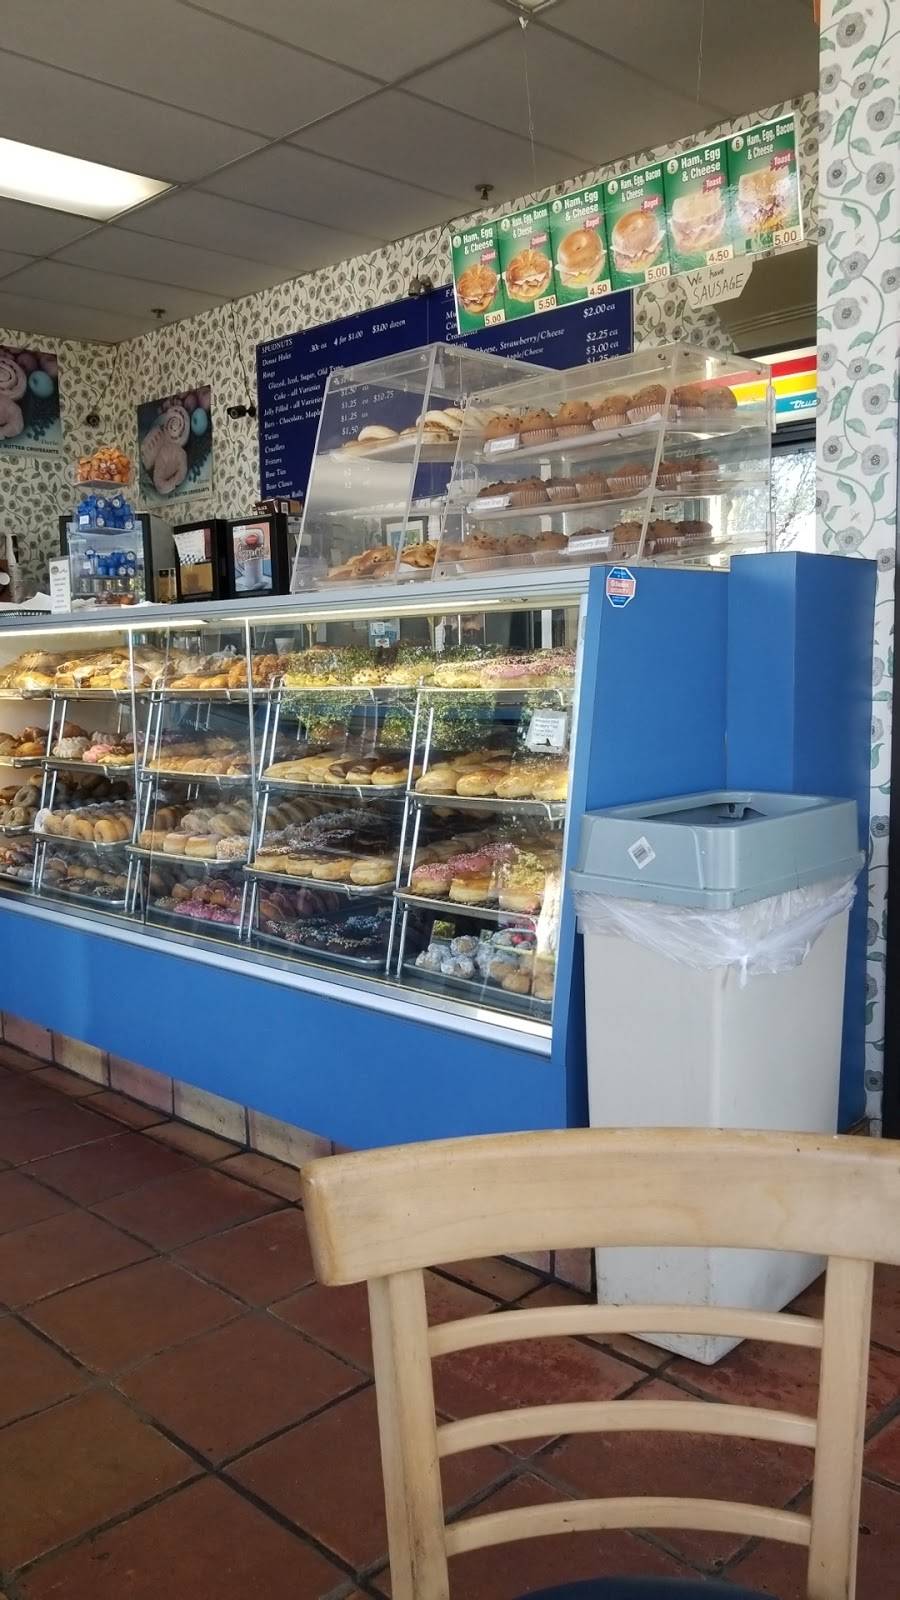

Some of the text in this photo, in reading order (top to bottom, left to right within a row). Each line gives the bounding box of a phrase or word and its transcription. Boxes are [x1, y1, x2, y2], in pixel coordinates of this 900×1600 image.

[746, 134, 761, 146] Ham,
[776, 122, 794, 136] Bacon
[753, 143, 774, 158] Cheese
[681, 155, 702, 169] Ham,
[704, 148, 721, 161] Egg
[774, 153, 791, 165] Toast
[682, 161, 721, 182] & Cheese
[564, 198, 583, 209] Ham,
[584, 191, 599, 203] Egg
[626, 188, 644, 200] Cheese
[565, 203, 599, 221] & Cheese
[463, 233, 479, 244] Ham,
[480, 227, 493, 238] Egg
[774, 230, 797, 245] 5.00
[470, 239, 494, 253] Cheese
[709, 249, 729, 262] 4.50
[647, 266, 668, 280] 5.00
[687, 267, 724, 287] We have
[590, 284, 607, 297] 4.50
[693, 272, 744, 305] SAUSAGE
[538, 297, 556, 310] 5.50
[583, 305, 606, 318] $2.00
[485, 313, 501, 325] 5.00
[278, 352, 292, 361] Holes
[348, 330, 364, 341] $1.00
[371, 323, 389, 334] $3.00
[389, 319, 406, 329] dozen
[586, 329, 608, 342] $2.25
[261, 338, 293, 354] SPUDNUTS
[586, 342, 609, 355] $3.00
[317, 367, 328, 376] Old
[790, 399, 817, 409] True
[341, 411, 357, 422] $1.25
